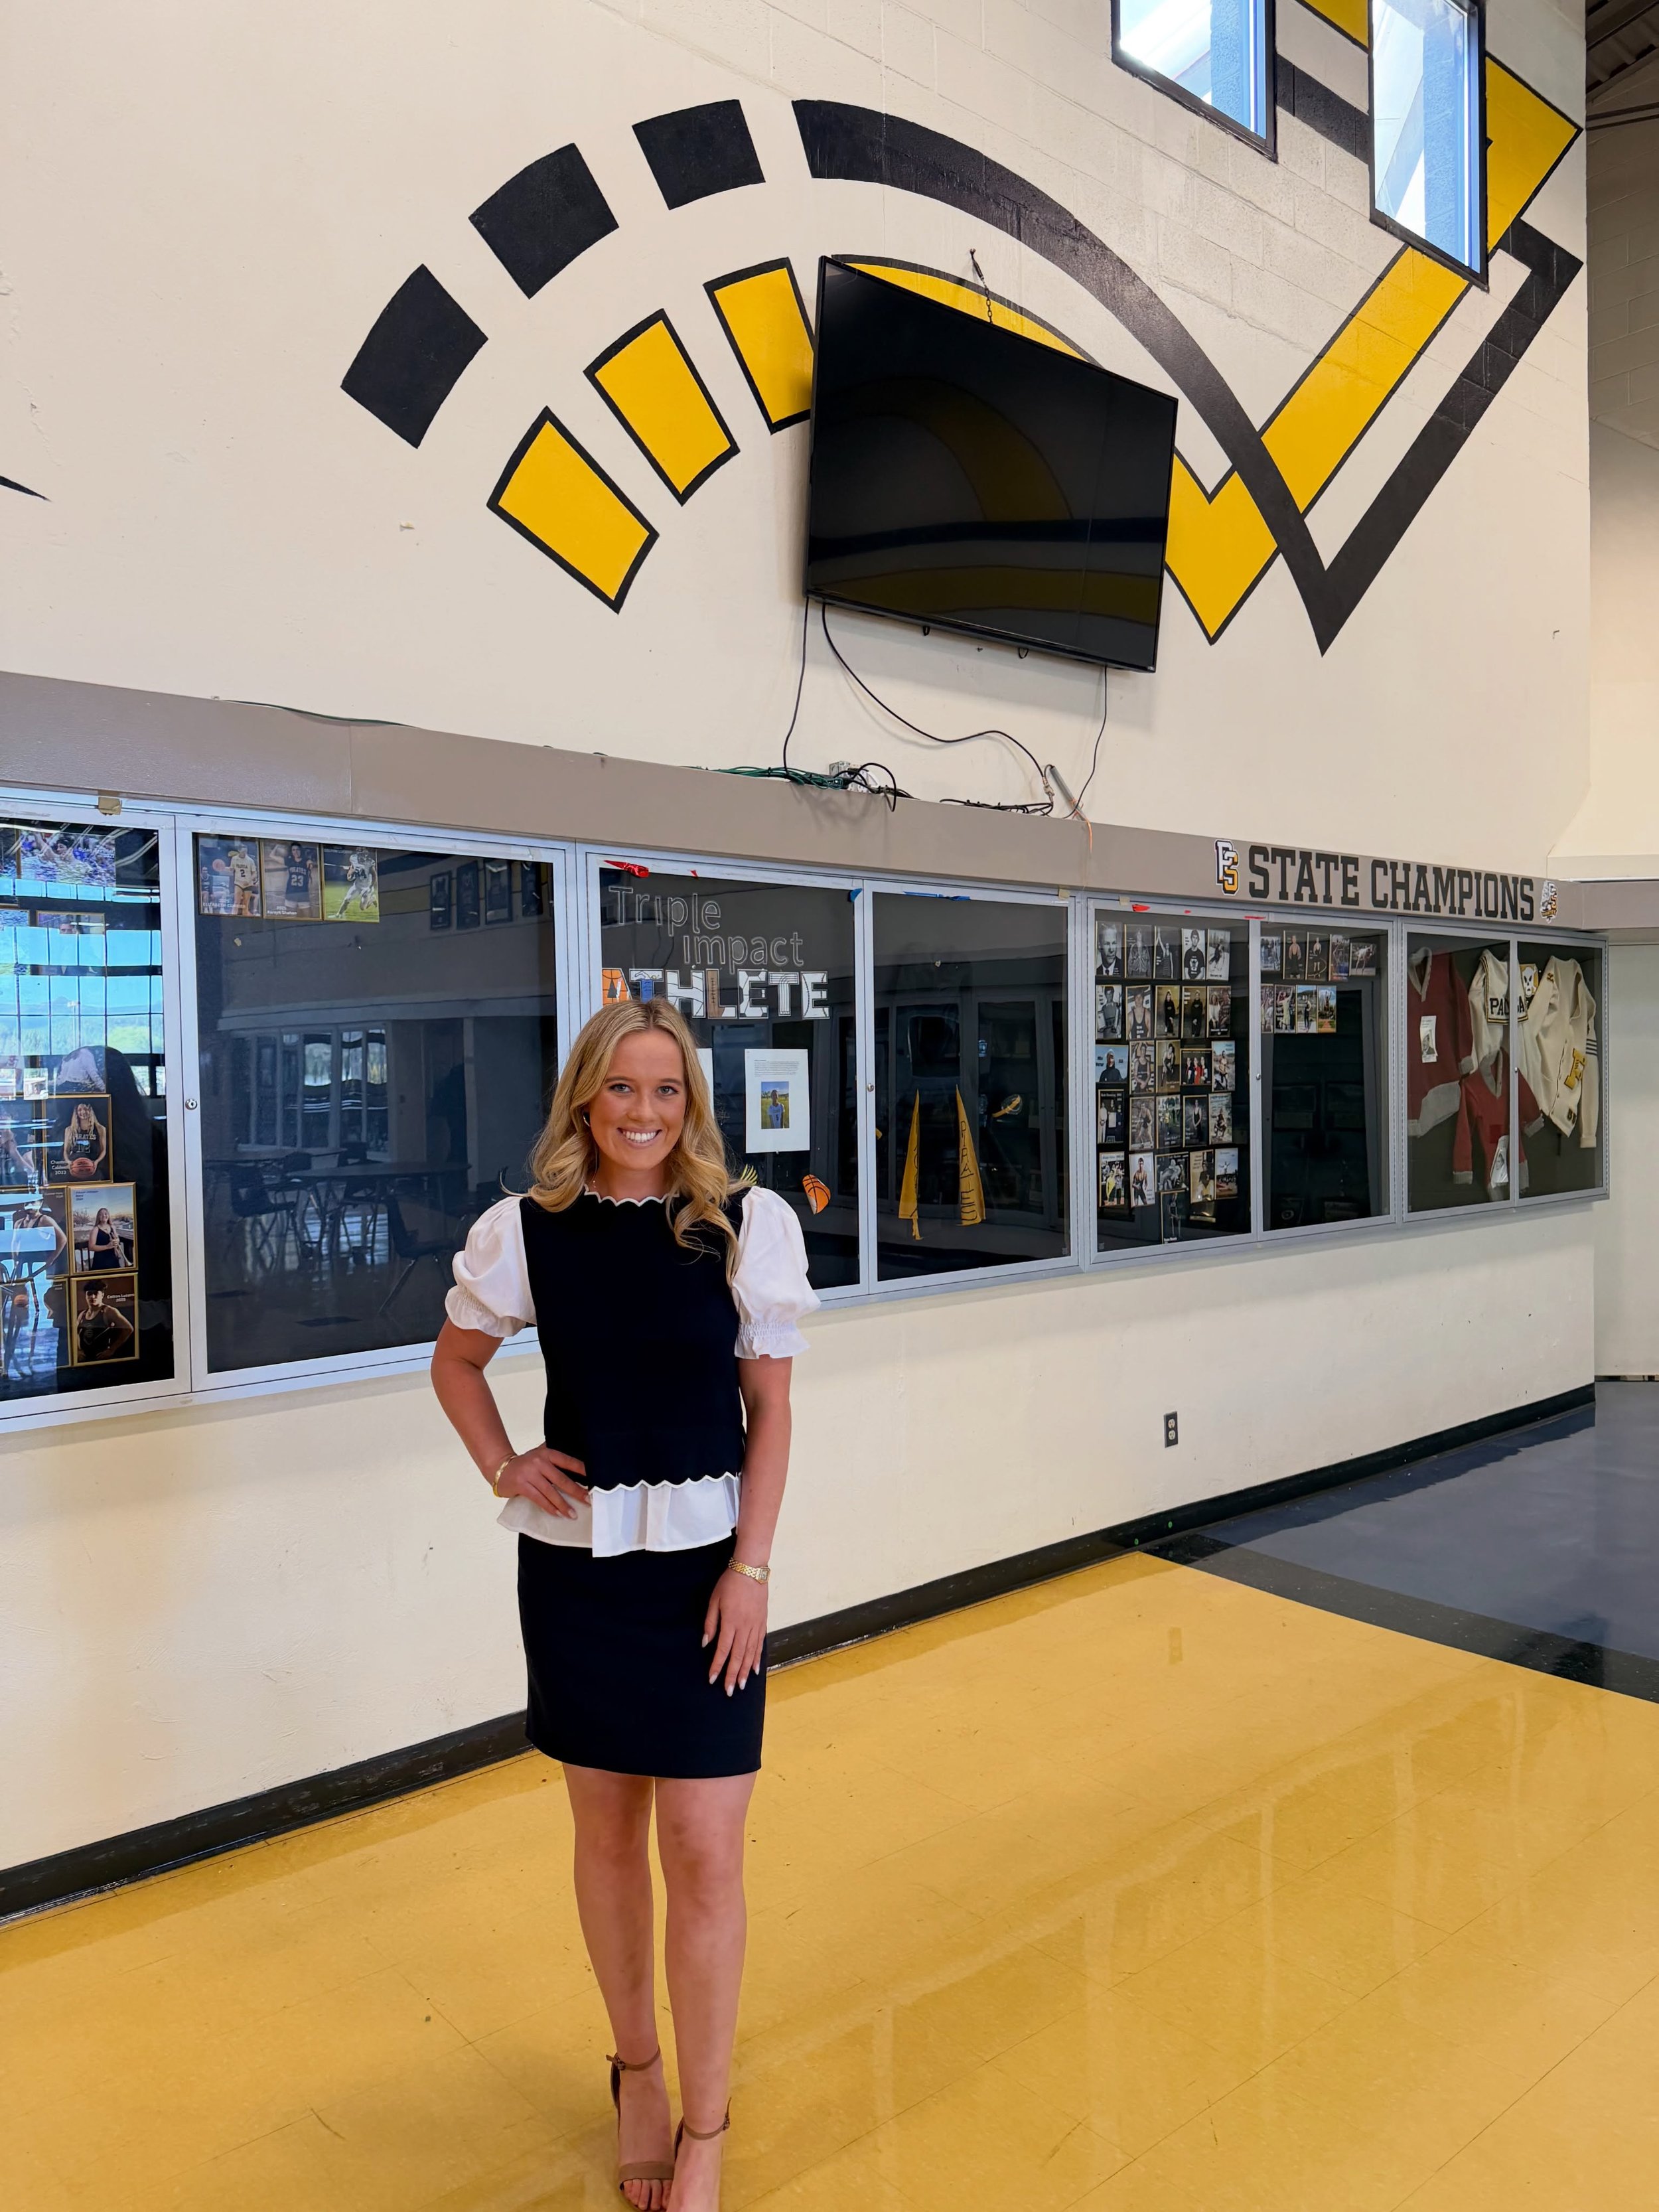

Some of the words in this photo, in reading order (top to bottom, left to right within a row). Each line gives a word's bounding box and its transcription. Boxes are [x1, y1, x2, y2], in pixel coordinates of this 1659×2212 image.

[291, 875, 304, 886] 23
[1249, 846, 1359, 907] STATE
[1371, 859, 1534, 921] CHAMPIONS
[609, 885, 721, 936] Triple
[682, 932, 805, 975] impact
[601, 968, 831, 1020] ATHLETE
